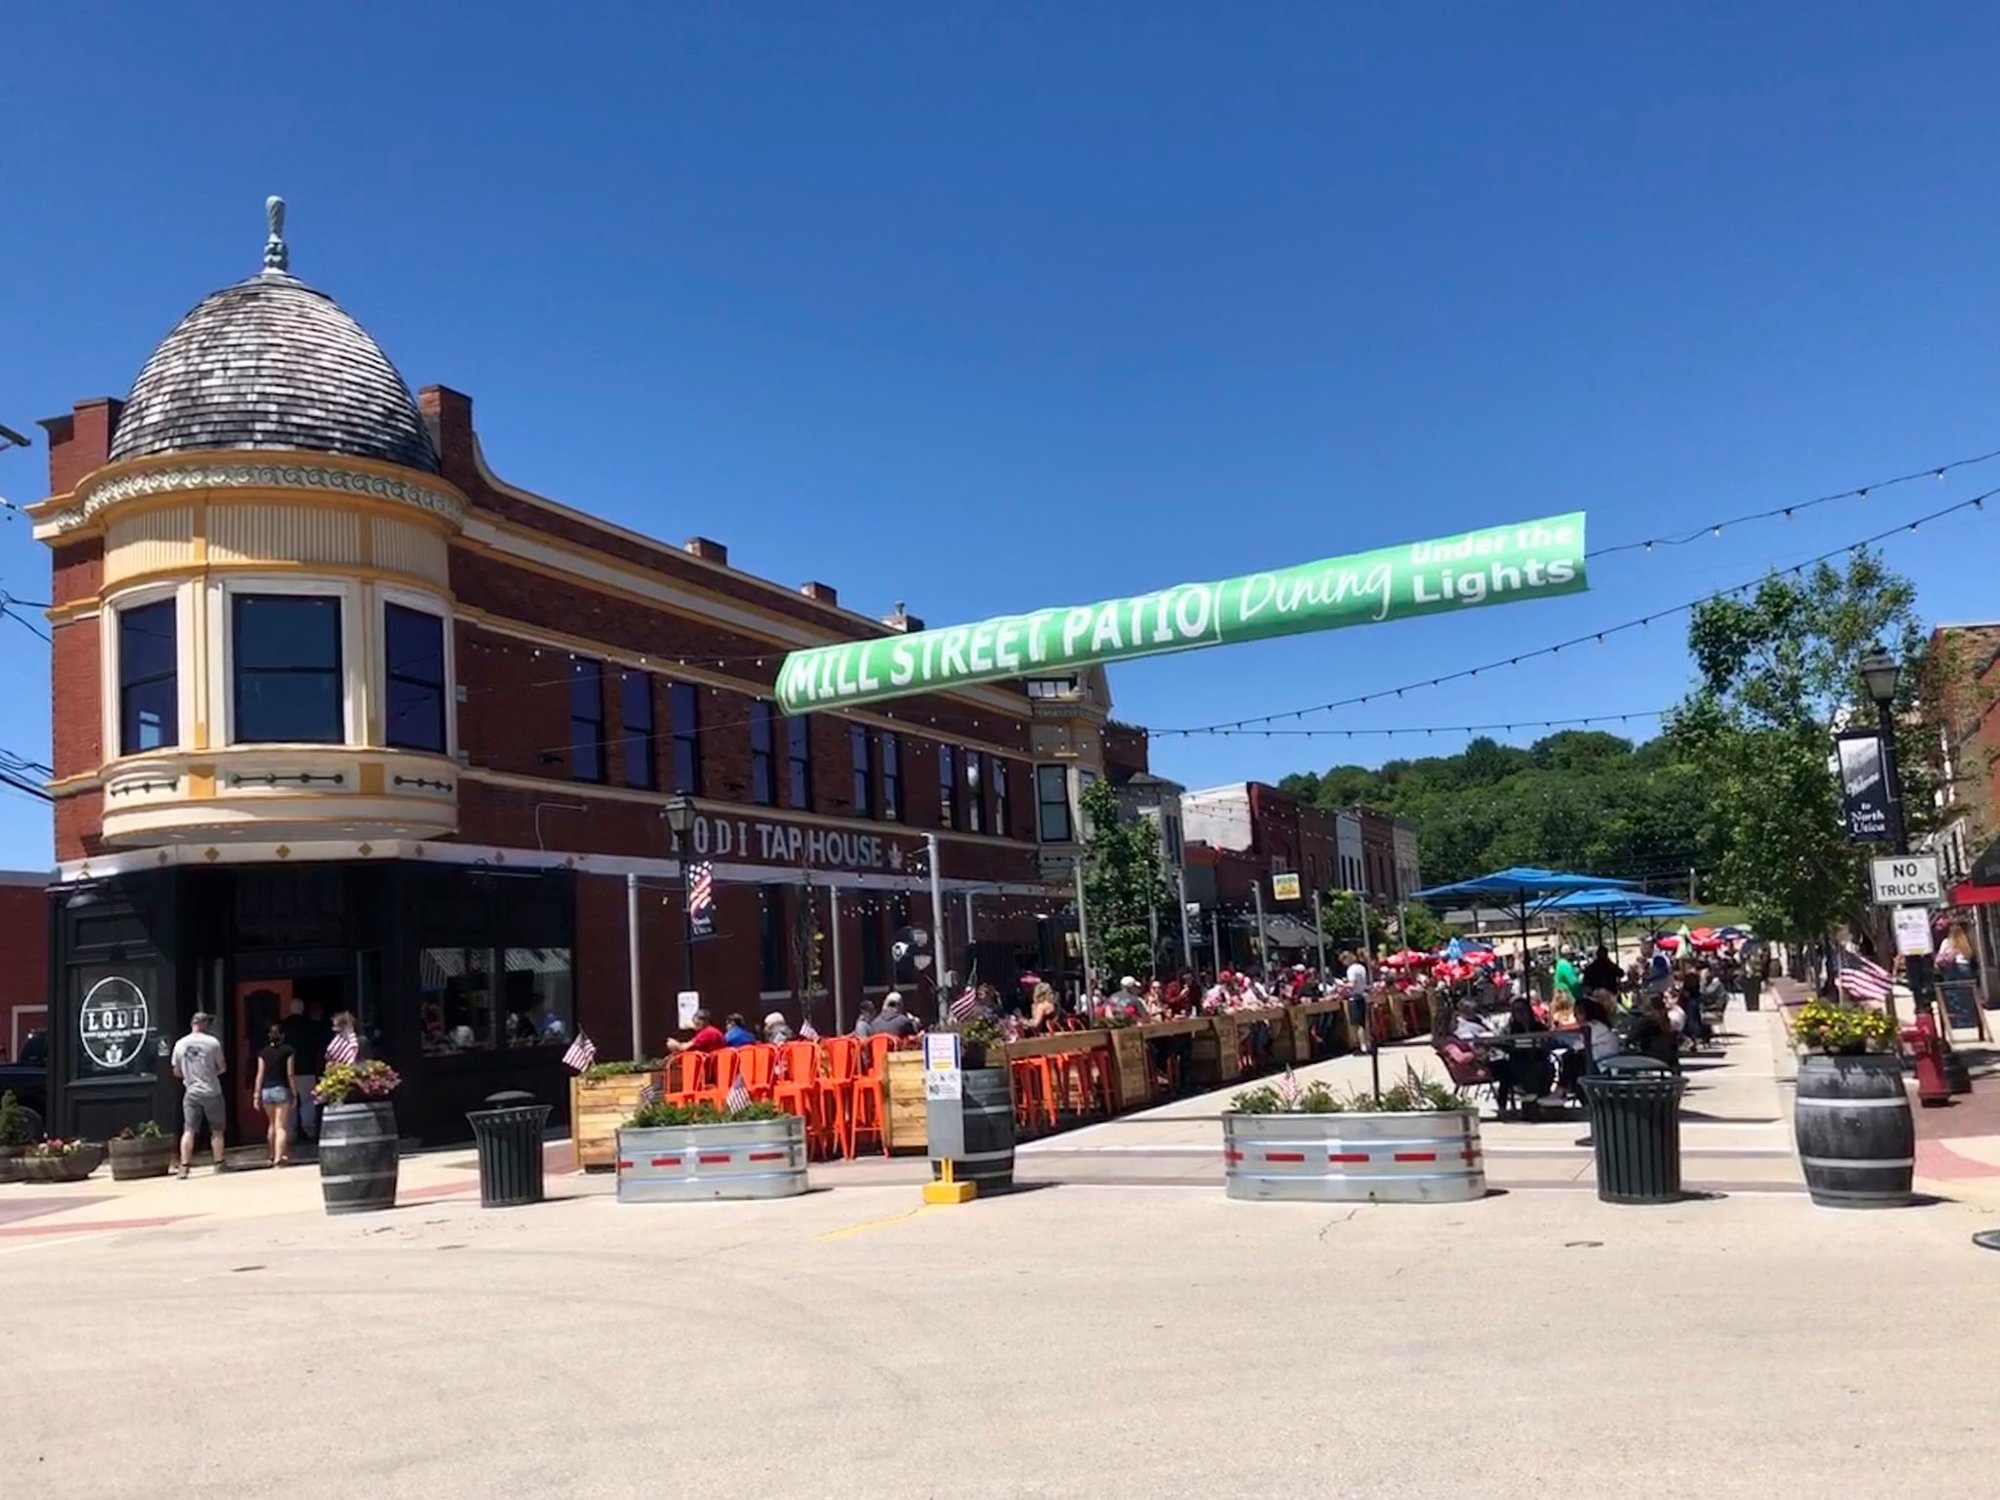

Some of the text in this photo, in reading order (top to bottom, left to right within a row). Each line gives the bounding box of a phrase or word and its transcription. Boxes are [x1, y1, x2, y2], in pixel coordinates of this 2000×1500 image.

[1411, 522, 1574, 563] Under the
[1239, 560, 1393, 621] Dining
[1413, 557, 1575, 605] Lights
[786, 585, 1210, 704] MILL STREET PATIO
[755, 823, 803, 861] TAP
[807, 829, 884, 867] HOUSE
[1880, 882, 1937, 896] TRUCKS
[1893, 862, 1918, 878] NO
[88, 1009, 141, 1031] LODI
